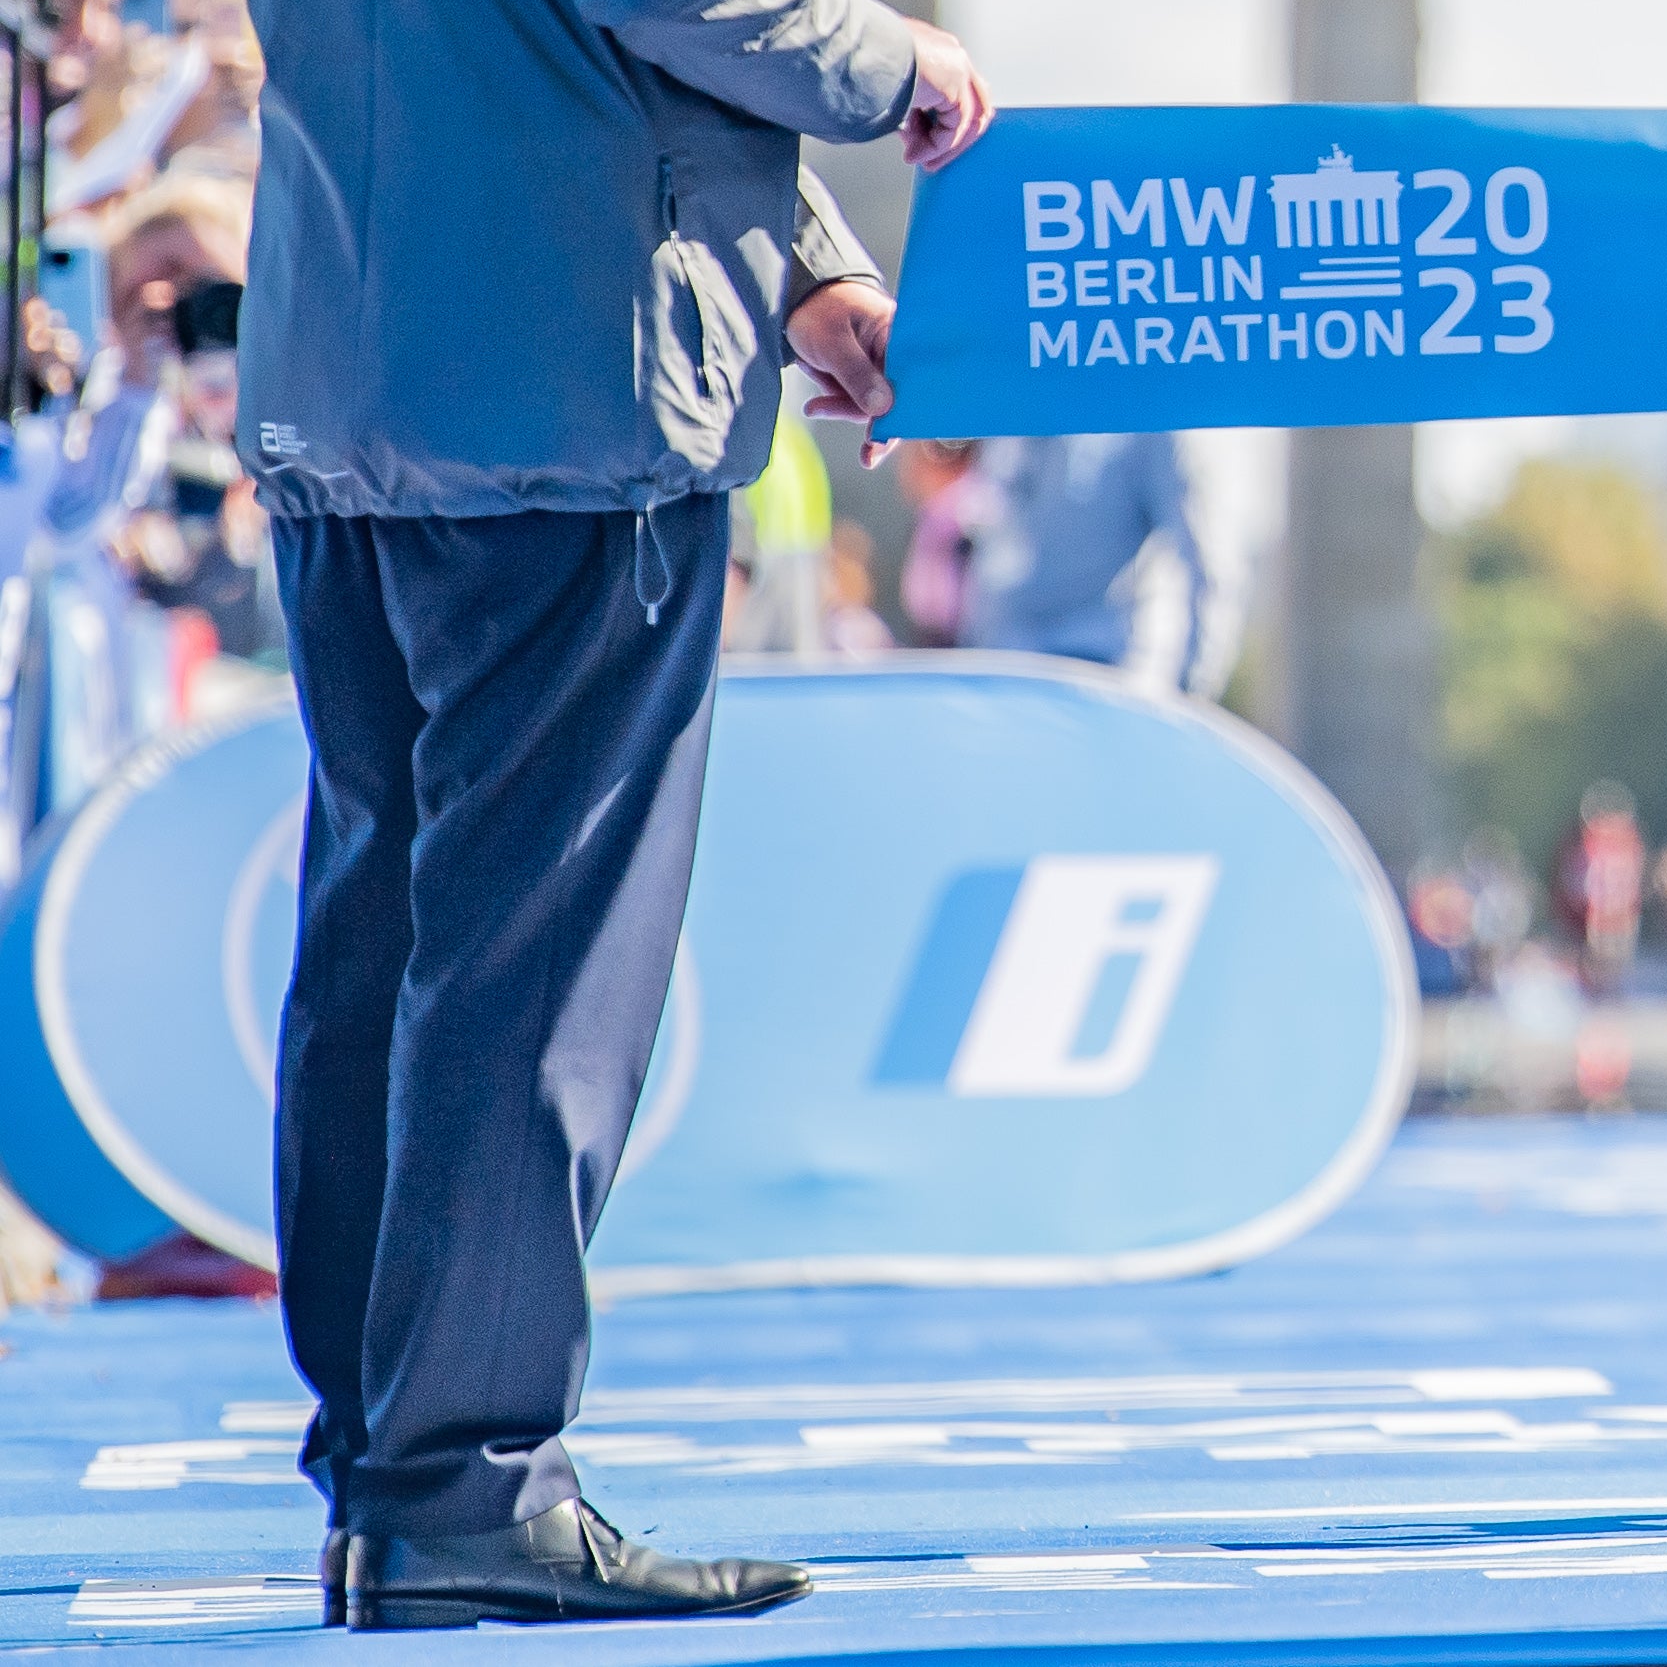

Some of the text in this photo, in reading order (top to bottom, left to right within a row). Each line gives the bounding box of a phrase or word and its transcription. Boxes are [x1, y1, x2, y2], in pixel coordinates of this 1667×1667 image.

[1024, 167, 1549, 255] BMW 20
[1028, 256, 1554, 354] BERLIN 23
[1031, 310, 1404, 368] MARATHON
